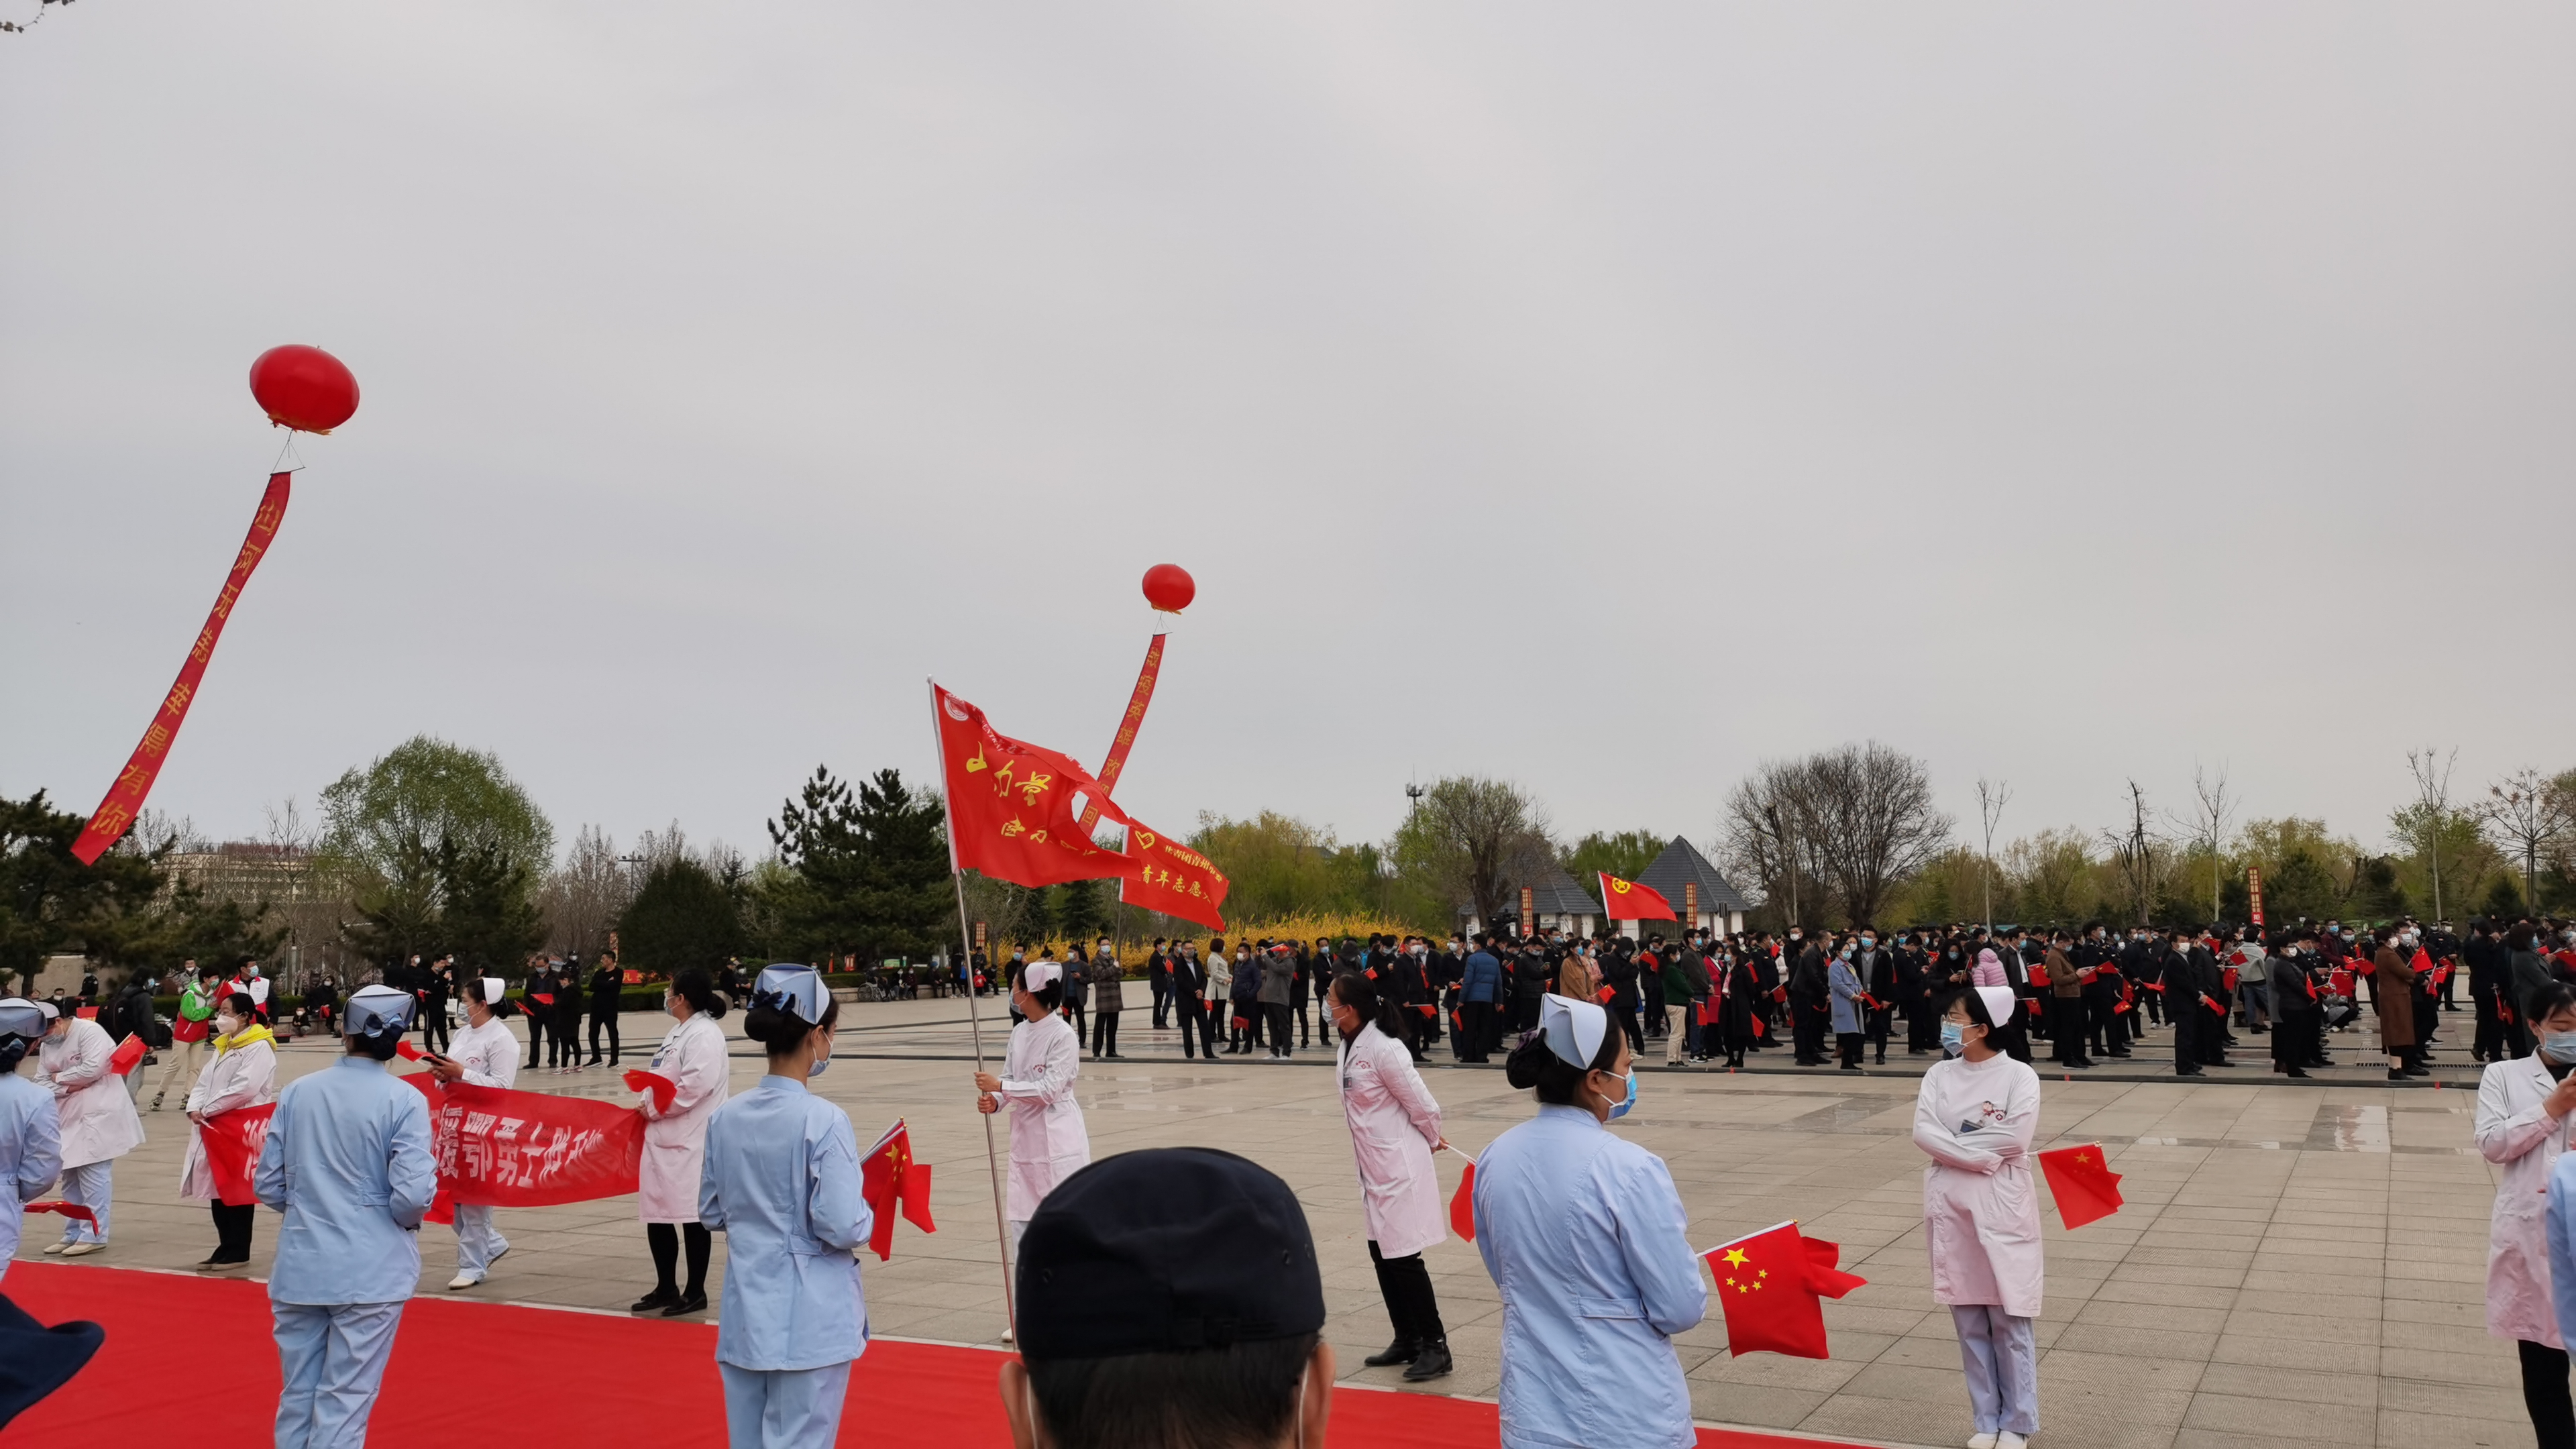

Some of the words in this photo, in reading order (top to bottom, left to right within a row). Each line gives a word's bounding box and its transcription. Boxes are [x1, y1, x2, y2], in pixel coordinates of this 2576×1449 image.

[91, 498, 281, 835] 山河无恙幸得有你
